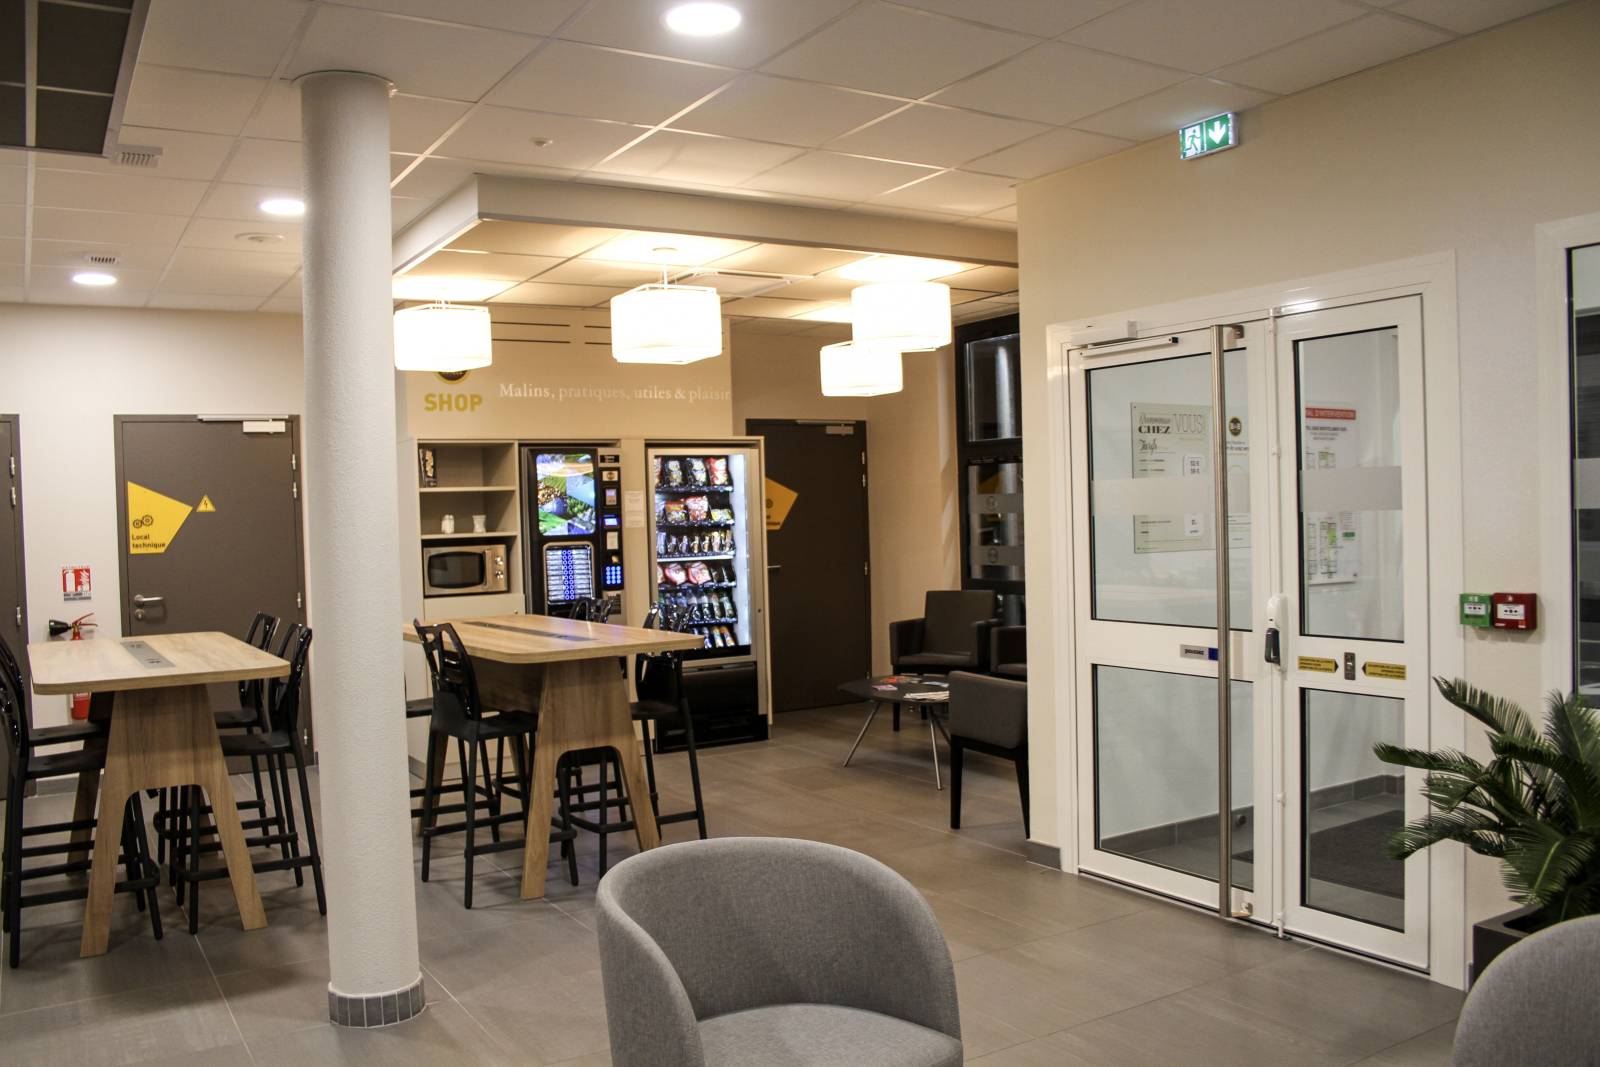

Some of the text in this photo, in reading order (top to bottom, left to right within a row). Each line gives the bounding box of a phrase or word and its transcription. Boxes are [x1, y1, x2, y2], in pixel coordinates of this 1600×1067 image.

[499, 384, 555, 399] Malins,
[559, 385, 631, 402] pratiques,
[634, 386, 671, 400] utiles
[674, 388, 687, 400] &
[424, 393, 483, 413] SHOP
[1138, 425, 1171, 434] CHEZ
[132, 533, 150, 541] Local
[132, 541, 166, 550] technique
